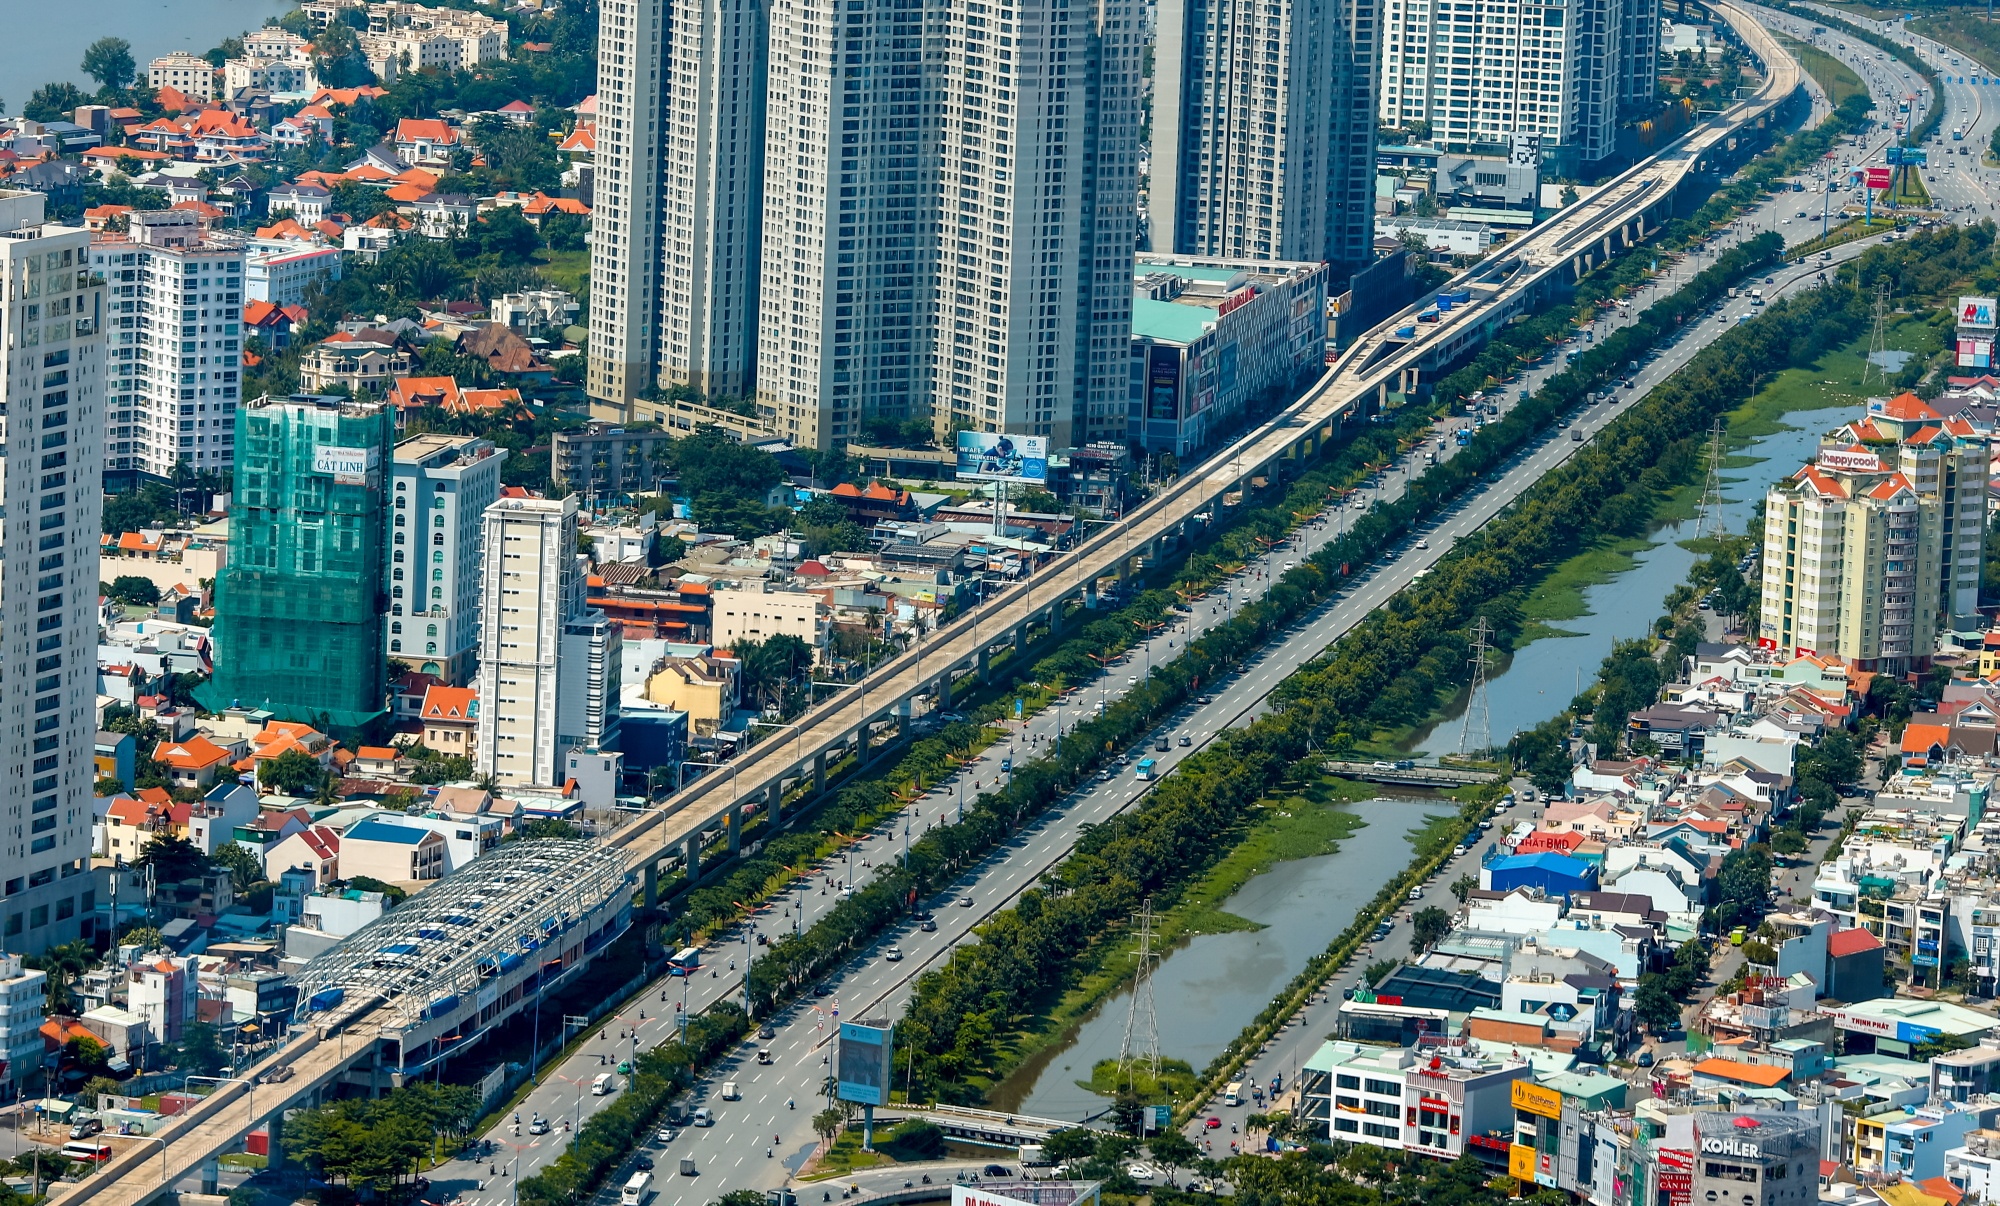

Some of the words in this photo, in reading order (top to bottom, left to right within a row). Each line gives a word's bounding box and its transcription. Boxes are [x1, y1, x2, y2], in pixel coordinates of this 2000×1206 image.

[968, 454, 998, 462] THINKERS
[1823, 452, 1876, 467] happycook
[318, 458, 338, 470] CÁT
[340, 462, 363, 472] LINH
[1500, 836, 1516, 847] NỘI
[1520, 838, 1545, 848] THẤT
[1546, 838, 1570, 850] BMD
[1763, 976, 1789, 988] HOTEL
[1852, 1018, 1871, 1028] THỊNH
[1872, 1021, 1890, 1030] PHÁT
[1421, 1102, 1448, 1111] SHOWROOM
[1702, 1138, 1759, 1158] KOHLER
